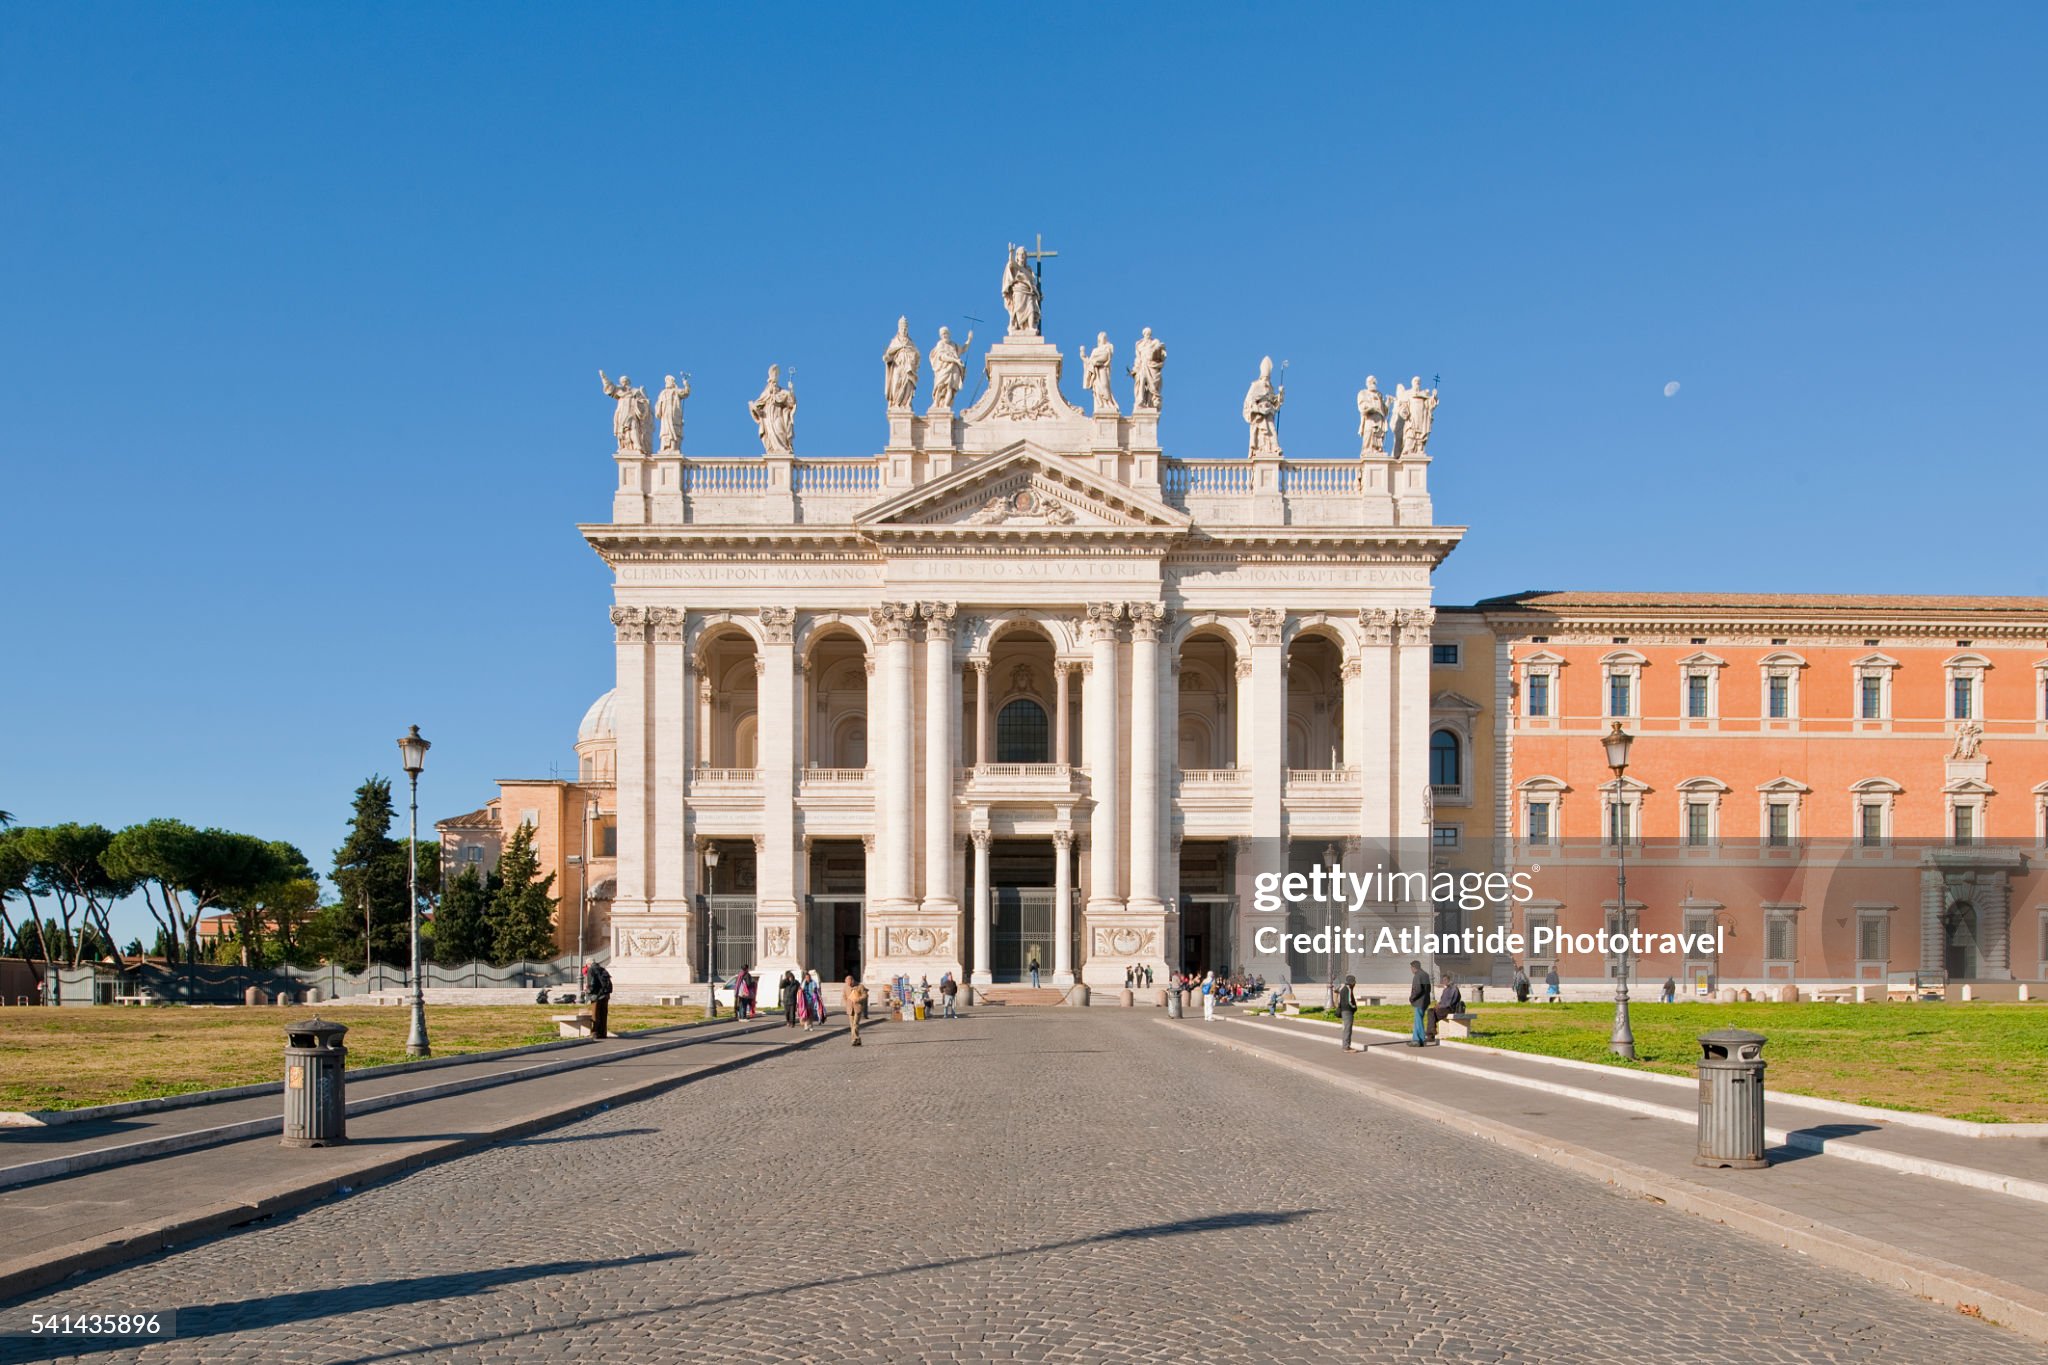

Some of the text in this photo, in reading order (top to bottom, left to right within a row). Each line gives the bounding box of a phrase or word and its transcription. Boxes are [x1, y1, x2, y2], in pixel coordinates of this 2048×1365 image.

[622, 568, 690, 580] CLEMENS
[697, 568, 718, 580] XII
[726, 568, 769, 580] PONT
[777, 568, 812, 580] MAX
[818, 568, 866, 580] ANNO
[911, 562, 1137, 576] CHRISTO SALVATORI
[1186, 570, 1217, 582] HON
[1298, 570, 1337, 582] BAPT
[1344, 570, 1361, 582] ET
[1369, 570, 1424, 582] EVANG
